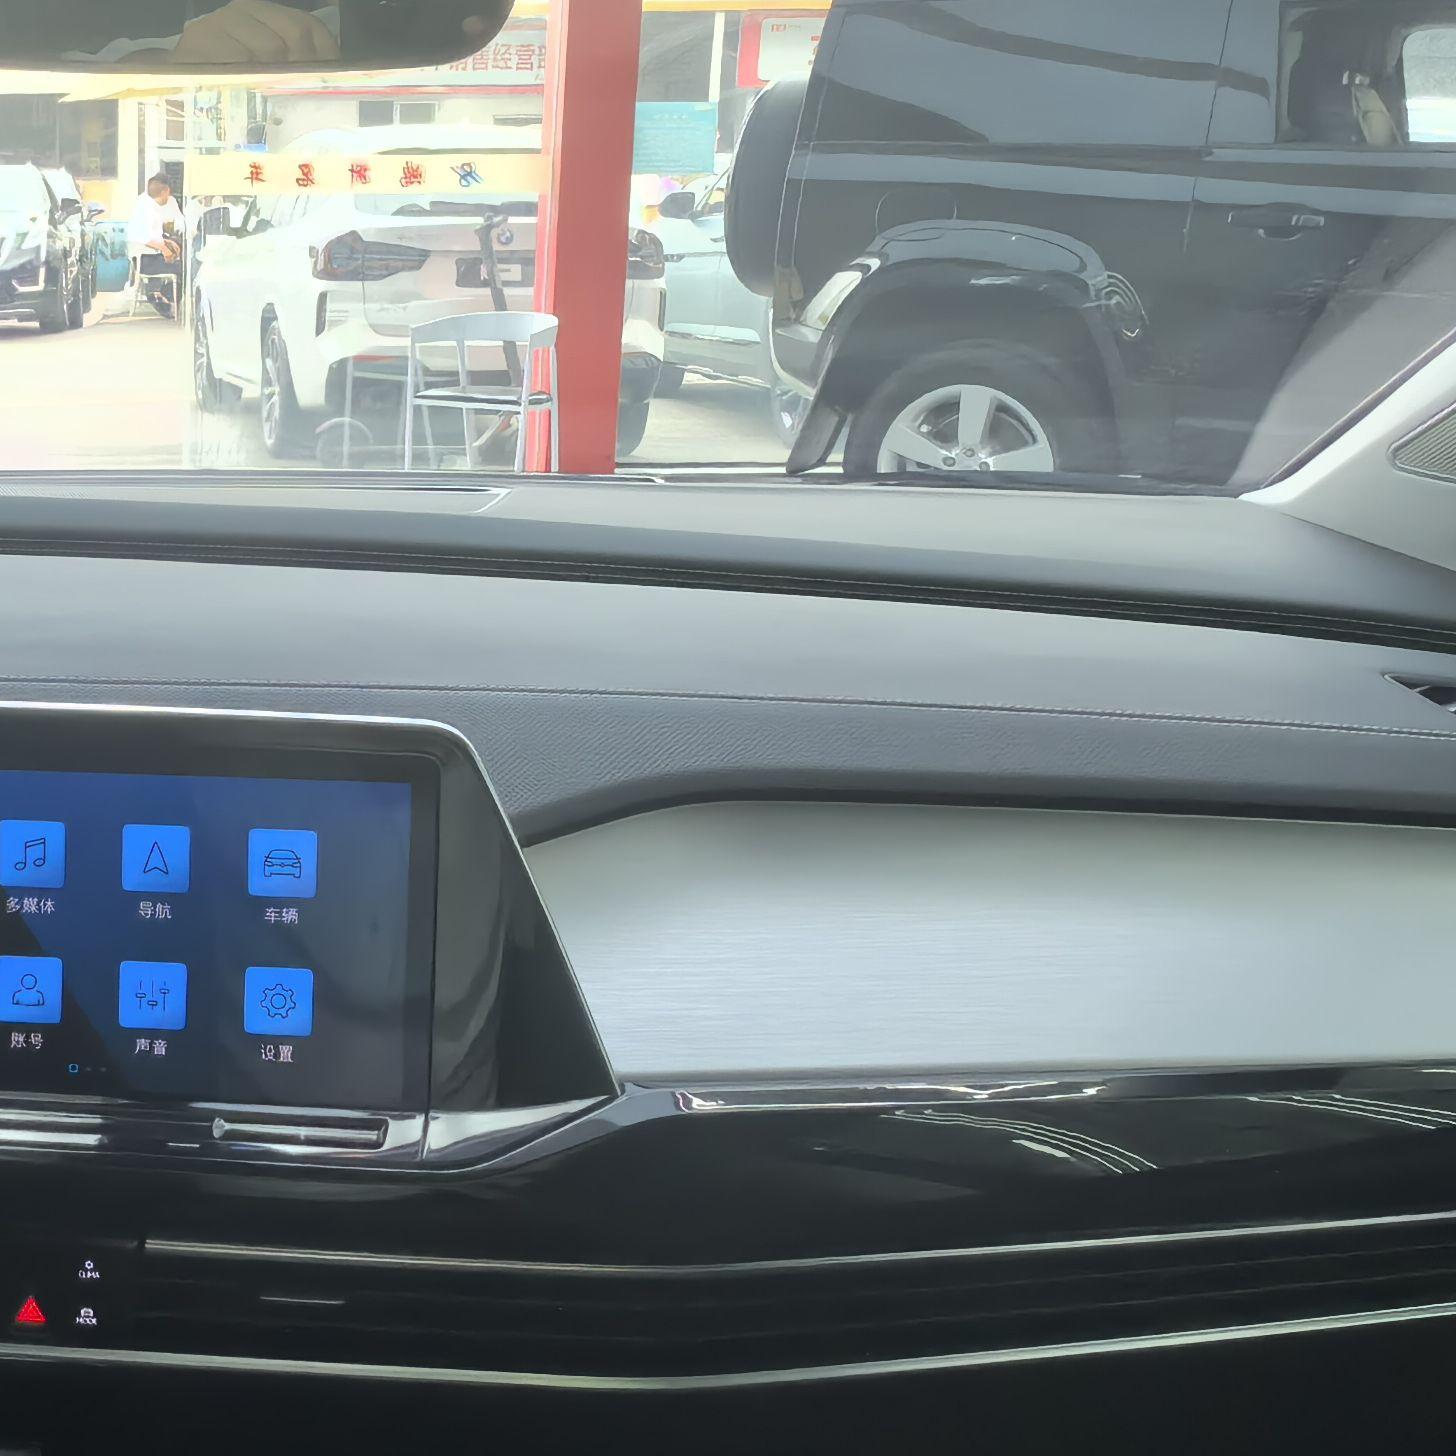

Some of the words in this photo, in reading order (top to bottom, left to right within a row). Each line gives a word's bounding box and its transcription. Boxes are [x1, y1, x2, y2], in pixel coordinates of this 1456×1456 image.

[5, 896, 56, 914] 多媒体
[138, 900, 172, 919] 导航
[264, 906, 299, 924] 车辆
[10, 1031, 44, 1050] 账号
[134, 1038, 168, 1056] 声音
[260, 1043, 294, 1063] 设置
